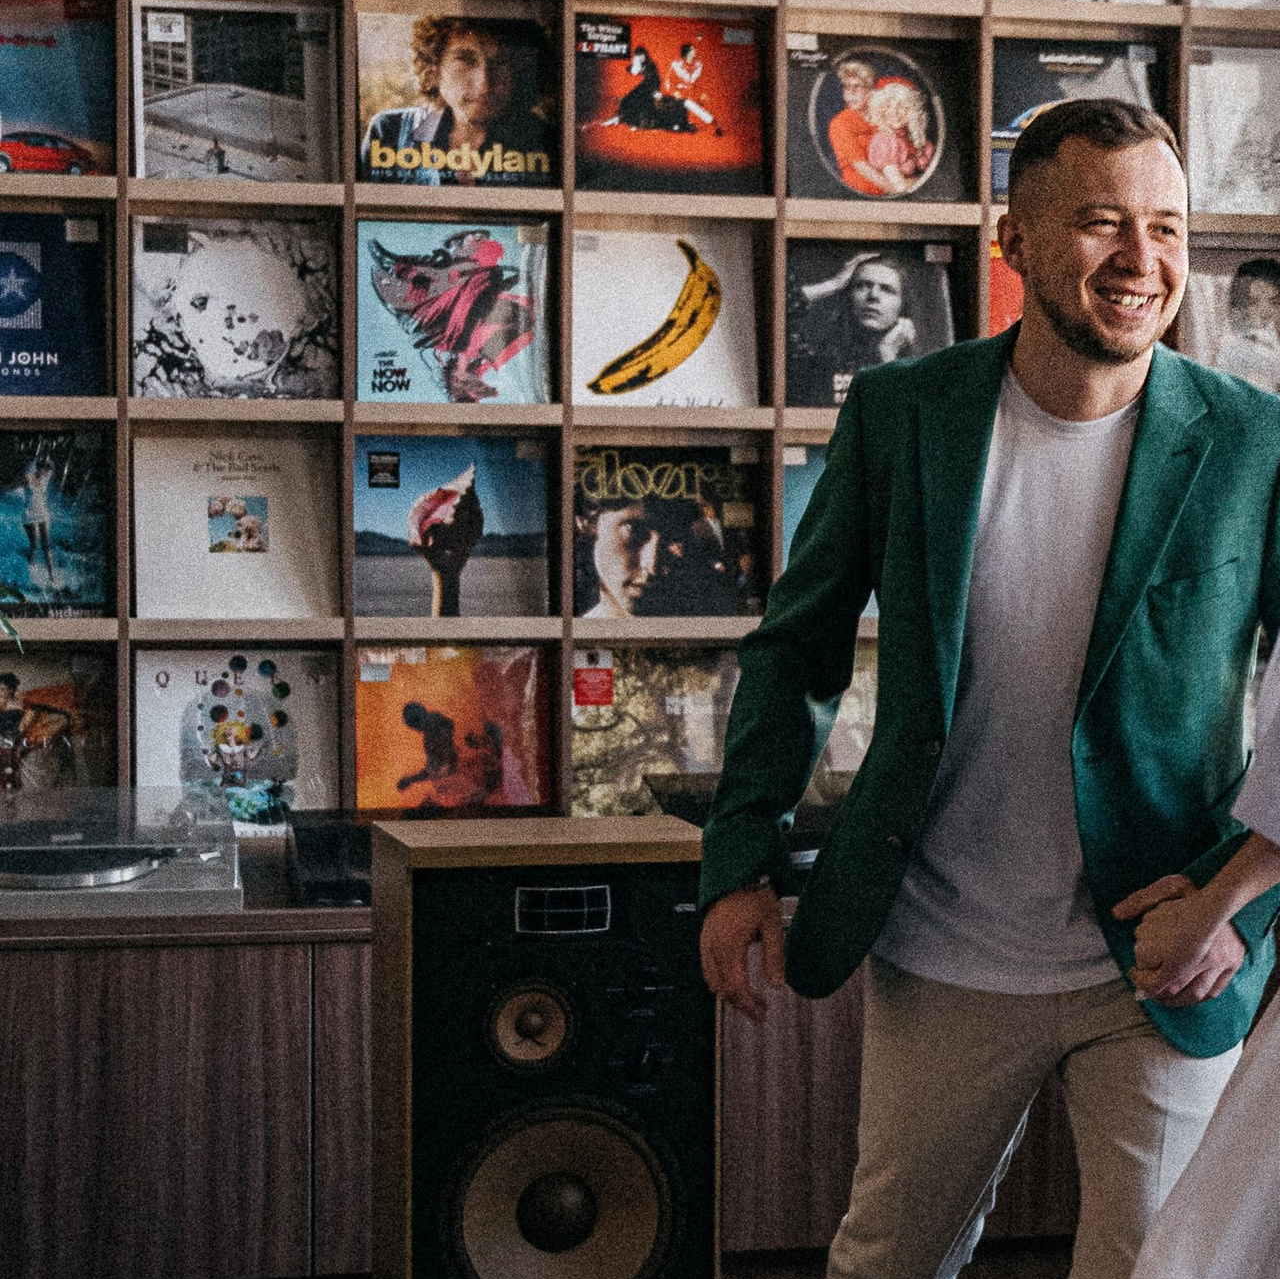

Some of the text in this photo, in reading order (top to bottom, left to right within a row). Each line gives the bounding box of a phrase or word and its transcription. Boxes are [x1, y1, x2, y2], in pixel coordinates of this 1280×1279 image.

[370, 138, 551, 179] bobdylan
[9, 350, 59, 366] JOHN
[373, 368, 408, 380] NOW
[371, 378, 412, 394] NOW
